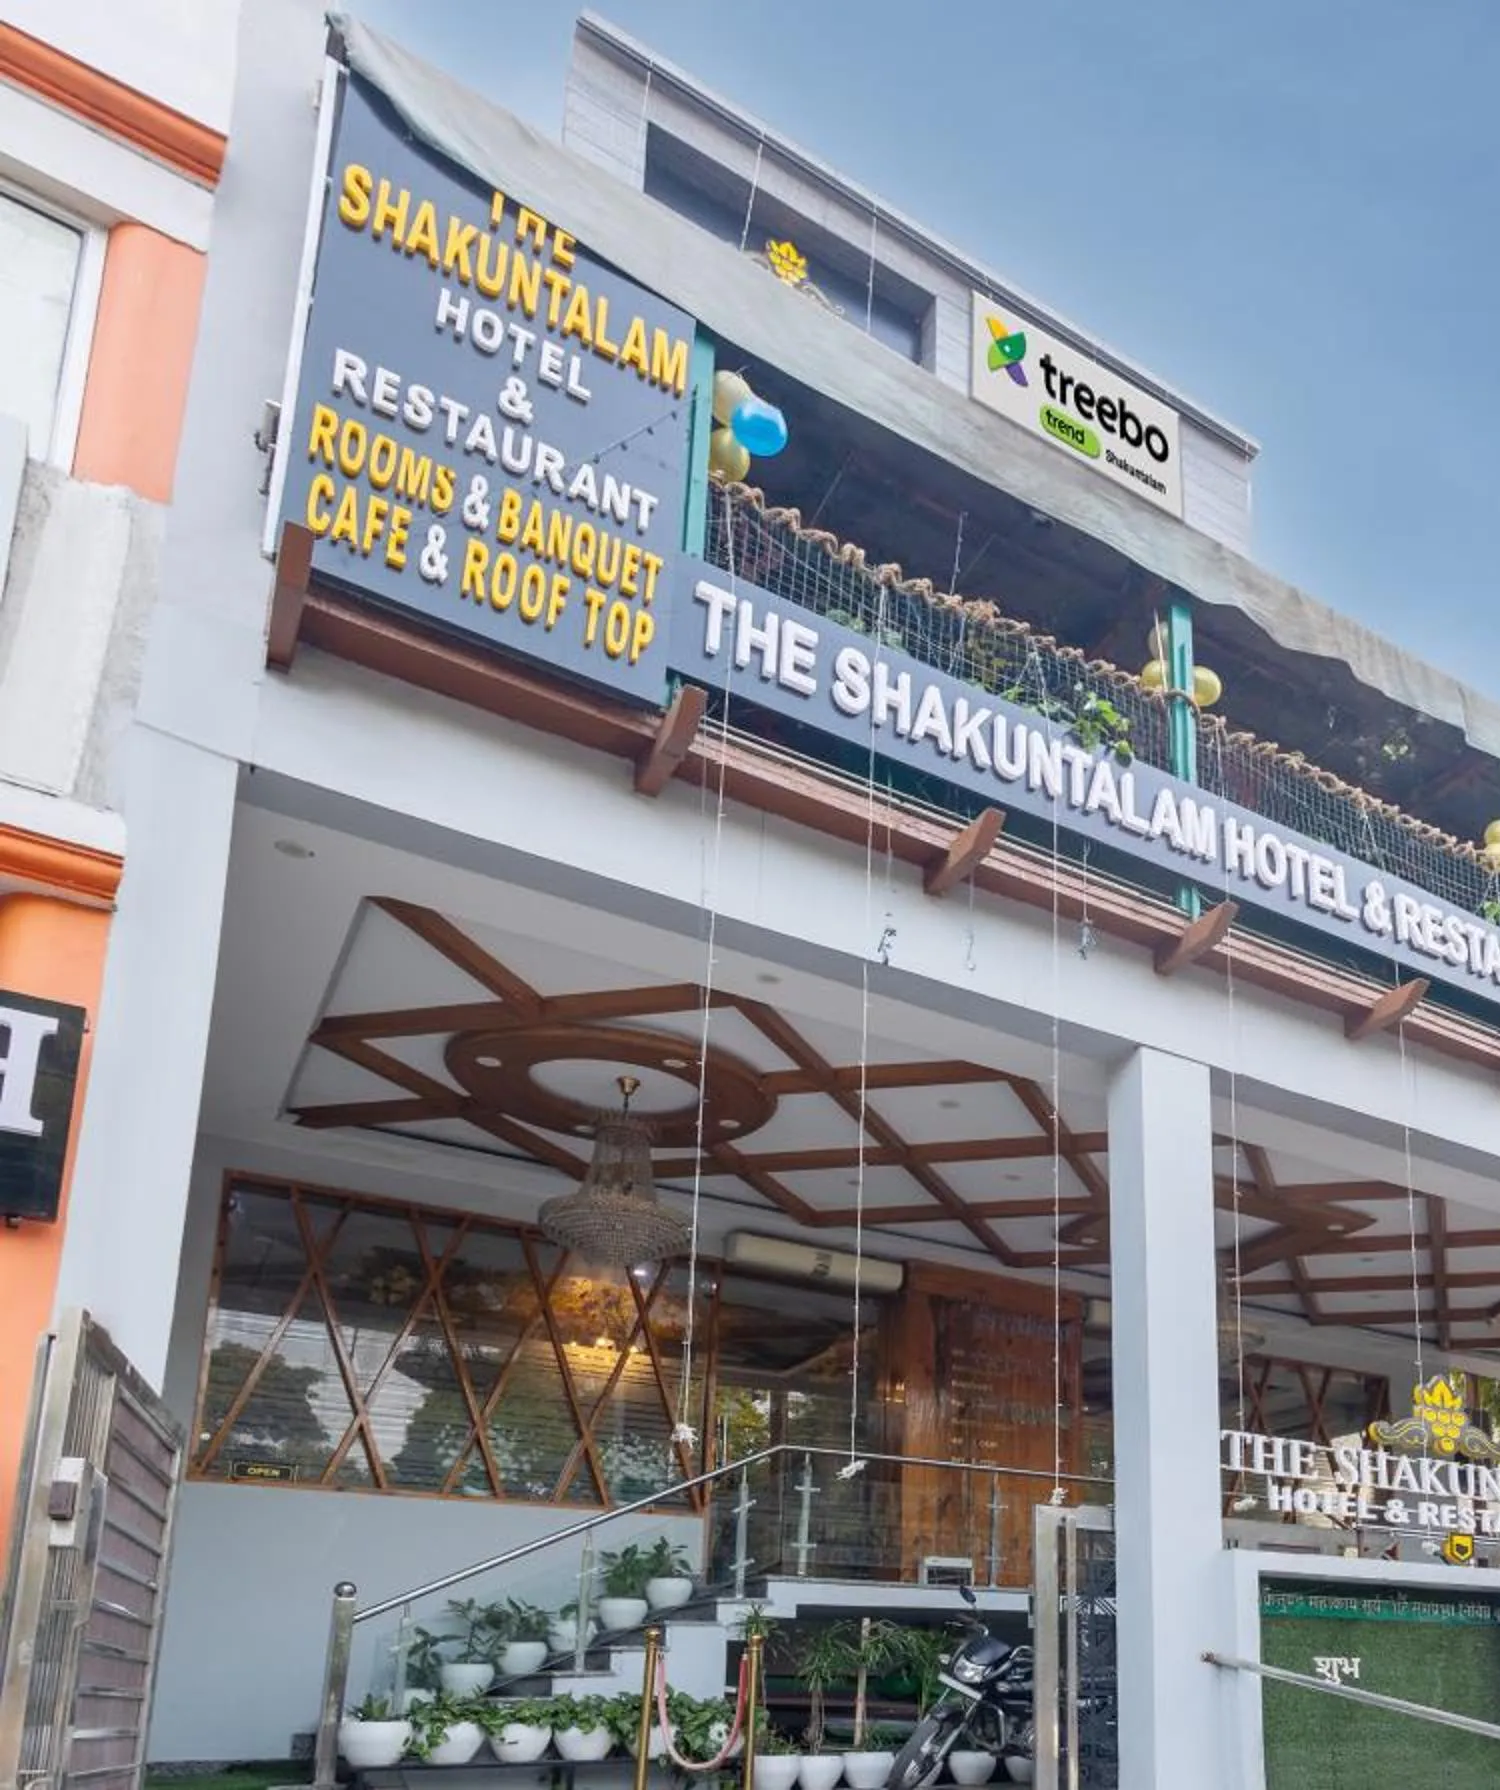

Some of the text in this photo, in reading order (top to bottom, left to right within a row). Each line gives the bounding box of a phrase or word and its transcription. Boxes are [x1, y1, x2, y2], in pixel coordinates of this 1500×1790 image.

[338, 163, 690, 397] SHAKUNTALAM
[434, 287, 592, 400] HOTEL
[332, 348, 659, 532] RESTAURANT
[498, 375, 534, 424] &
[1039, 353, 1169, 463] treebo
[1045, 409, 1085, 445] trend
[307, 404, 664, 604] ROOMS & BANQUET
[306, 473, 657, 666] CAFE & ROOF TOP
[694, 580, 819, 697] THE
[831, 645, 1217, 864] SHAKUNTALAM
[1222, 816, 1361, 922] HOTEL
[1362, 878, 1394, 937] &
[1221, 1430, 1319, 1480] THE
[1268, 1481, 1377, 1520] HOTEL
[1384, 1499, 1410, 1524] &
[1313, 1656, 1361, 1684] शुभ
